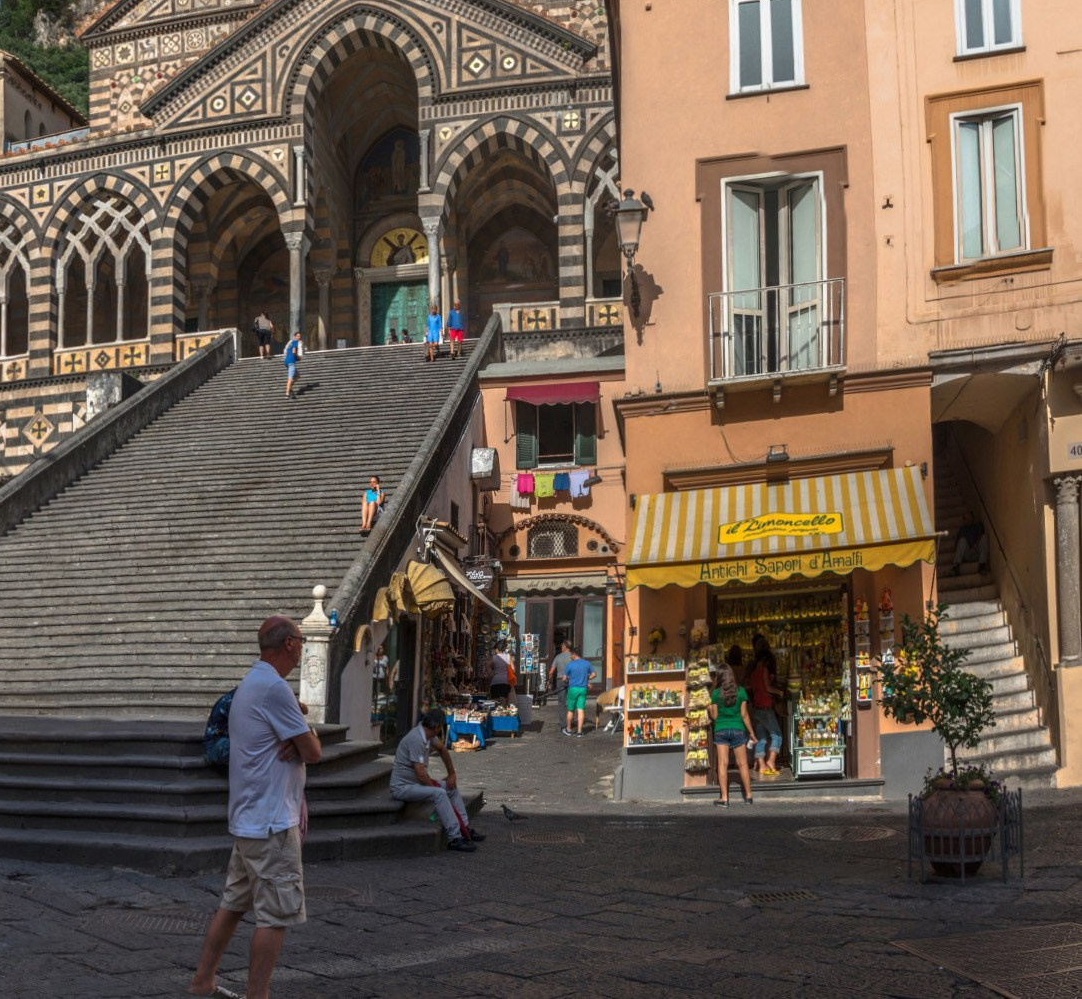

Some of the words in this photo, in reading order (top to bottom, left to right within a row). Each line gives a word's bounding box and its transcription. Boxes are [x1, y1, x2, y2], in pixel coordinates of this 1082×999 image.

[726, 523, 741, 535] il
[744, 515, 835, 532] Limoncello
[699, 562, 748, 580] Antichi
[755, 556, 802, 576] Sapori
[809, 551, 863, 569] d'Amalfi
